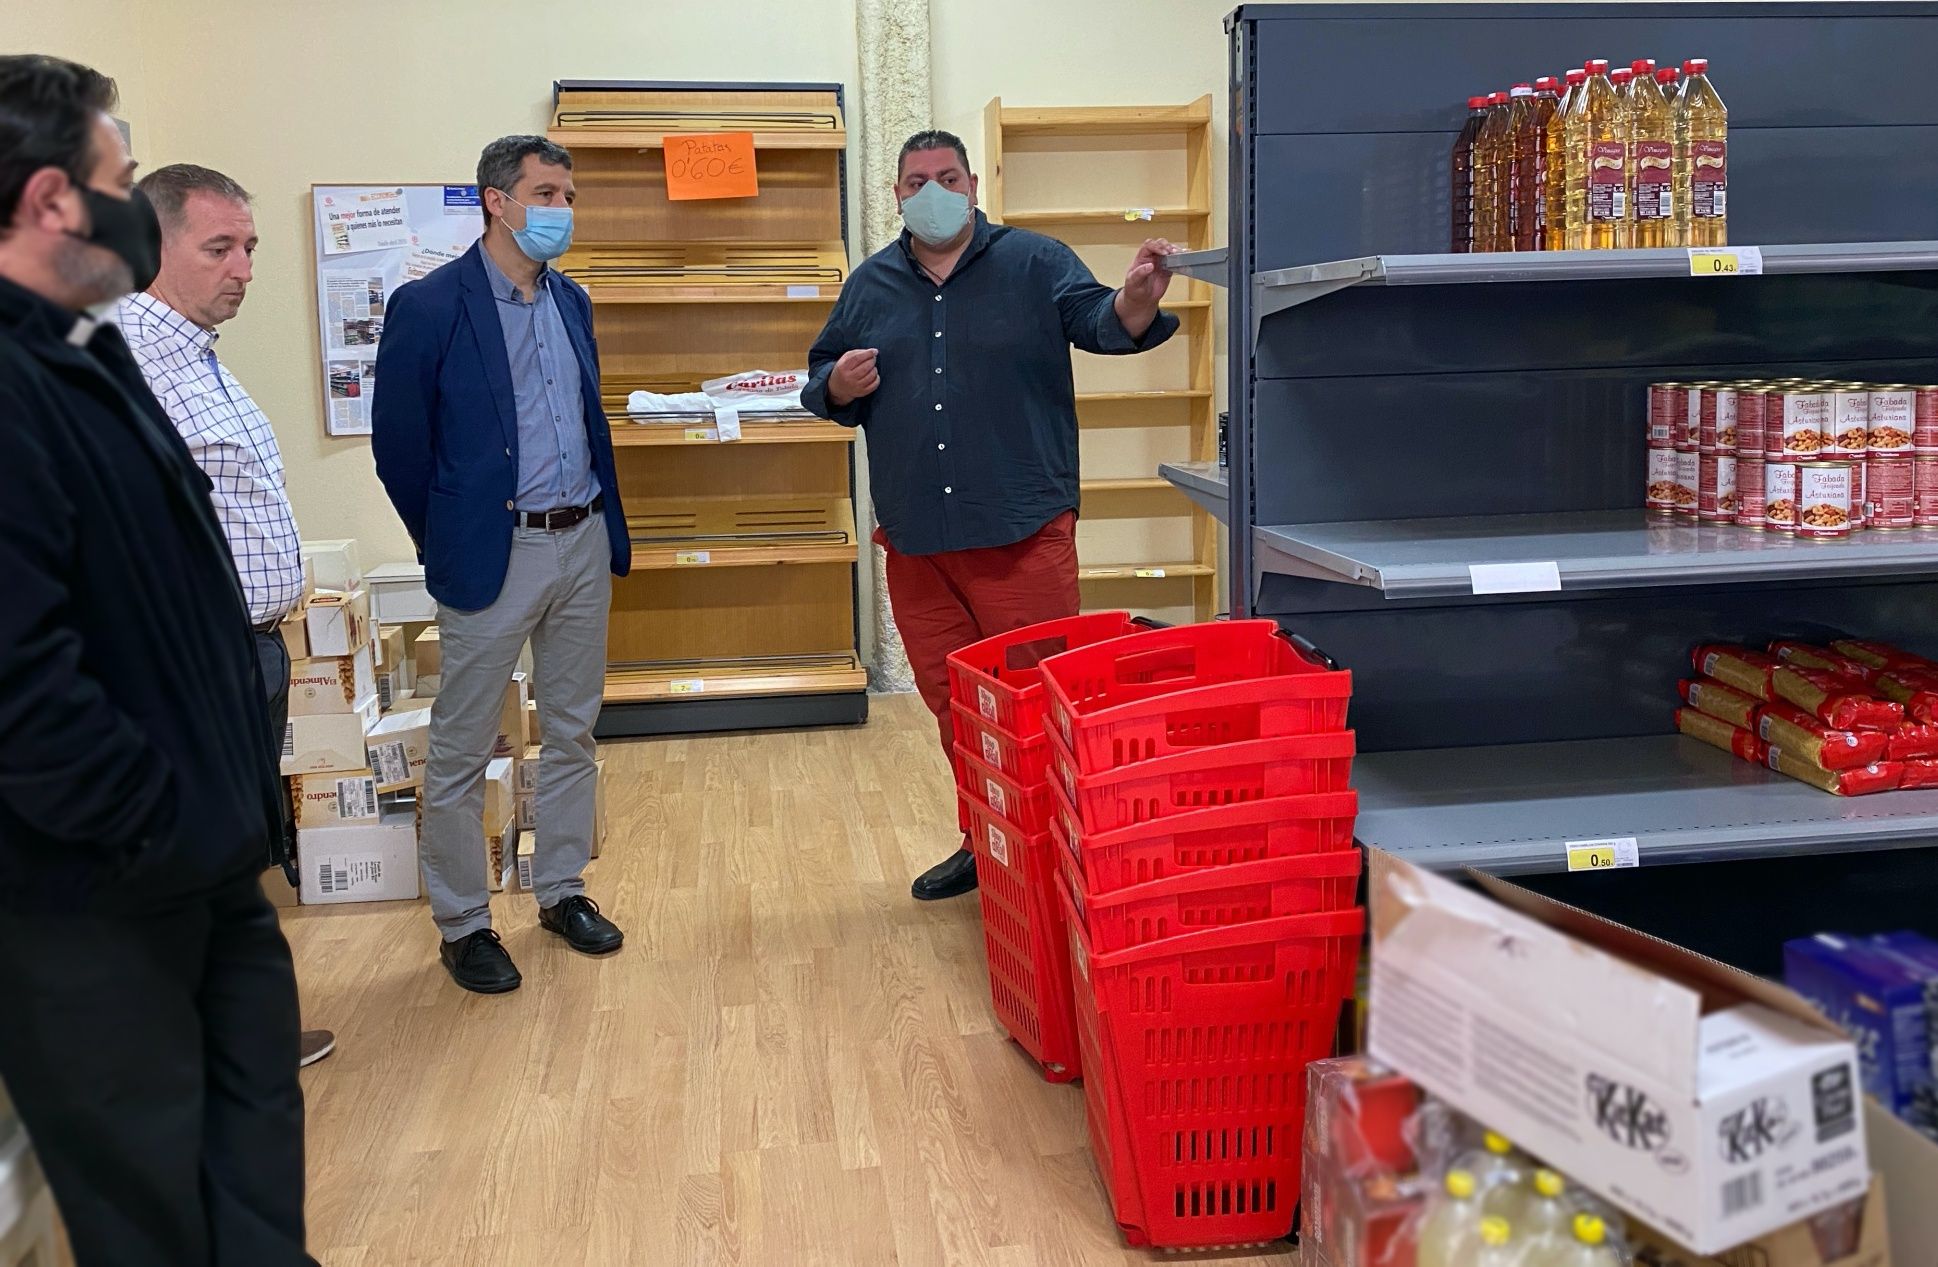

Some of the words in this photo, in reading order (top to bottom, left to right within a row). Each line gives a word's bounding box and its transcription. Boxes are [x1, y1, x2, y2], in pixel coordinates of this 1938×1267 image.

[680, 139, 732, 155] Patatas
[328, 212, 340, 221] Una
[340, 211, 356, 221] mejor
[356, 209, 373, 218] forma
[373, 207, 381, 216] de
[380, 205, 401, 215] atender
[350, 221, 368, 232] quienes
[382, 217, 403, 227] necesitan
[1874, 396, 1907, 407] Fabada
[1774, 469, 1796, 480] Faba
[1811, 473, 1846, 484] Fabada
[1805, 490, 1846, 500] Asturiana
[290, 676, 332, 686] Almendr
